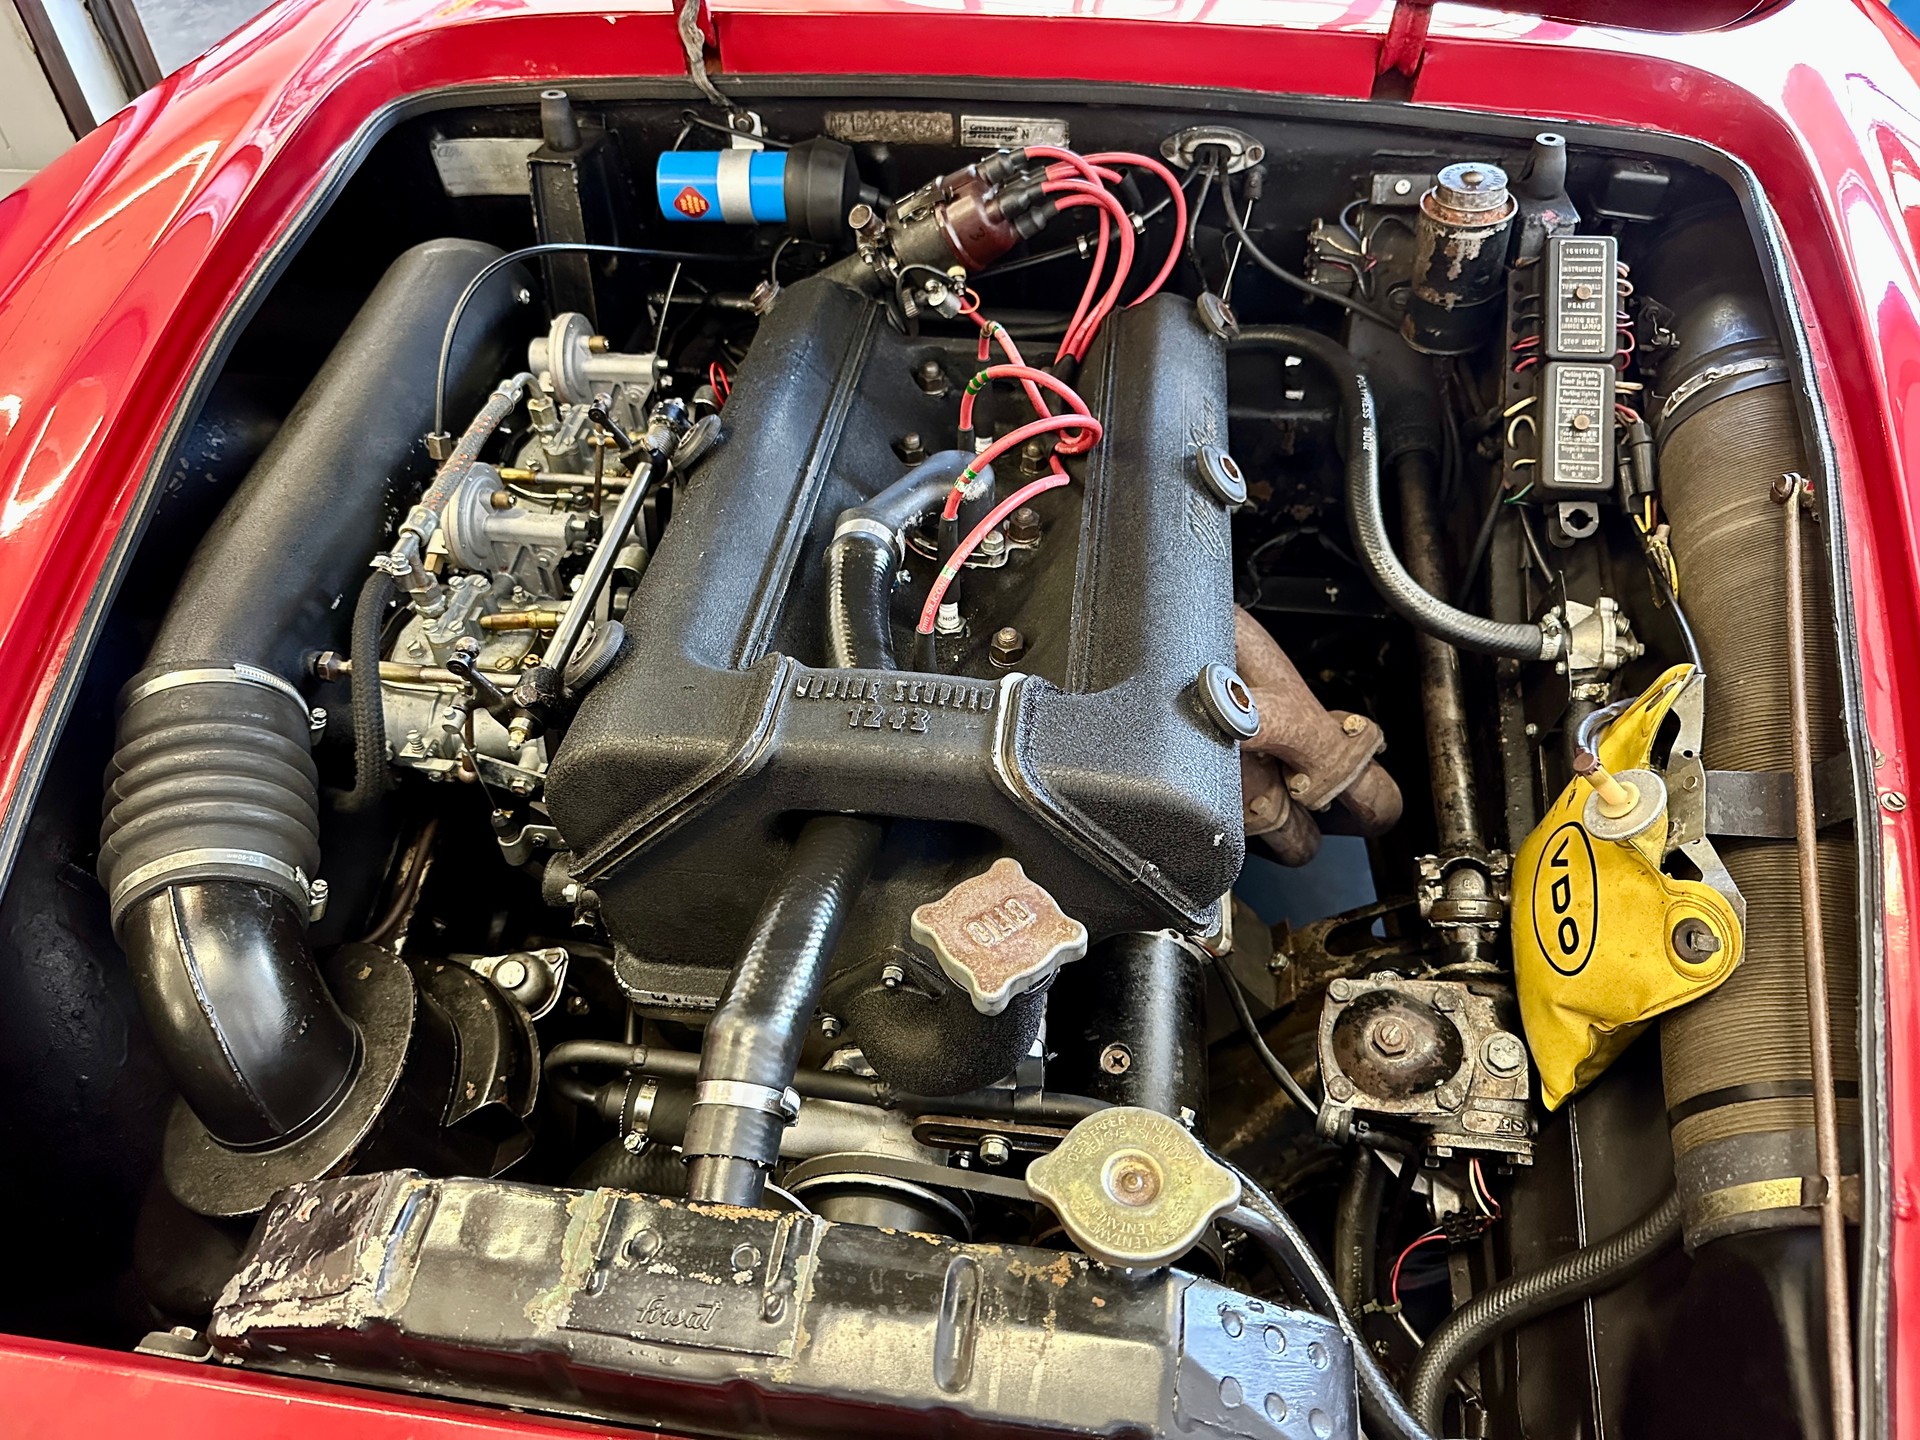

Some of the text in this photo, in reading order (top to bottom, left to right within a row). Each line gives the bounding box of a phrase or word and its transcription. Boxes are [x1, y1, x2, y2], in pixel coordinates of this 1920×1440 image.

[1567, 302, 1596, 310] HEATER
[1356, 374, 1371, 420] POLYPRESS
[925, 577, 949, 616] SILICONE
[847, 703, 930, 734] 1243
[1550, 835, 1580, 956] VDO
[1138, 1128, 1185, 1161] SLOWLY
